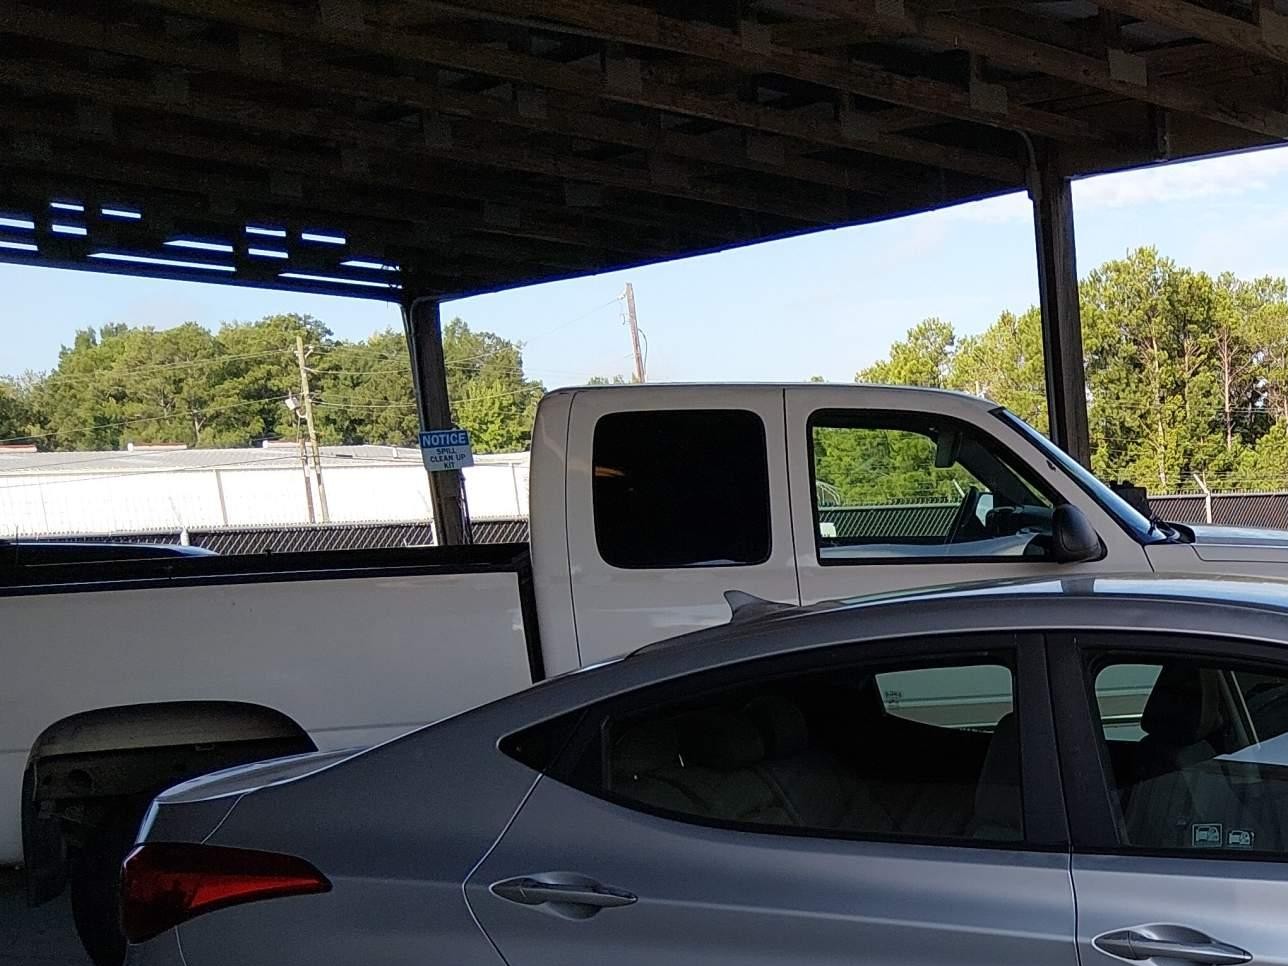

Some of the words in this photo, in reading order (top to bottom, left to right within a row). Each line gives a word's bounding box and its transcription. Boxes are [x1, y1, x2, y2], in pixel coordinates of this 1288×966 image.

[422, 432, 466, 447] NOTICE
[430, 454, 454, 463] CLEAN
[455, 453, 466, 462] UP
